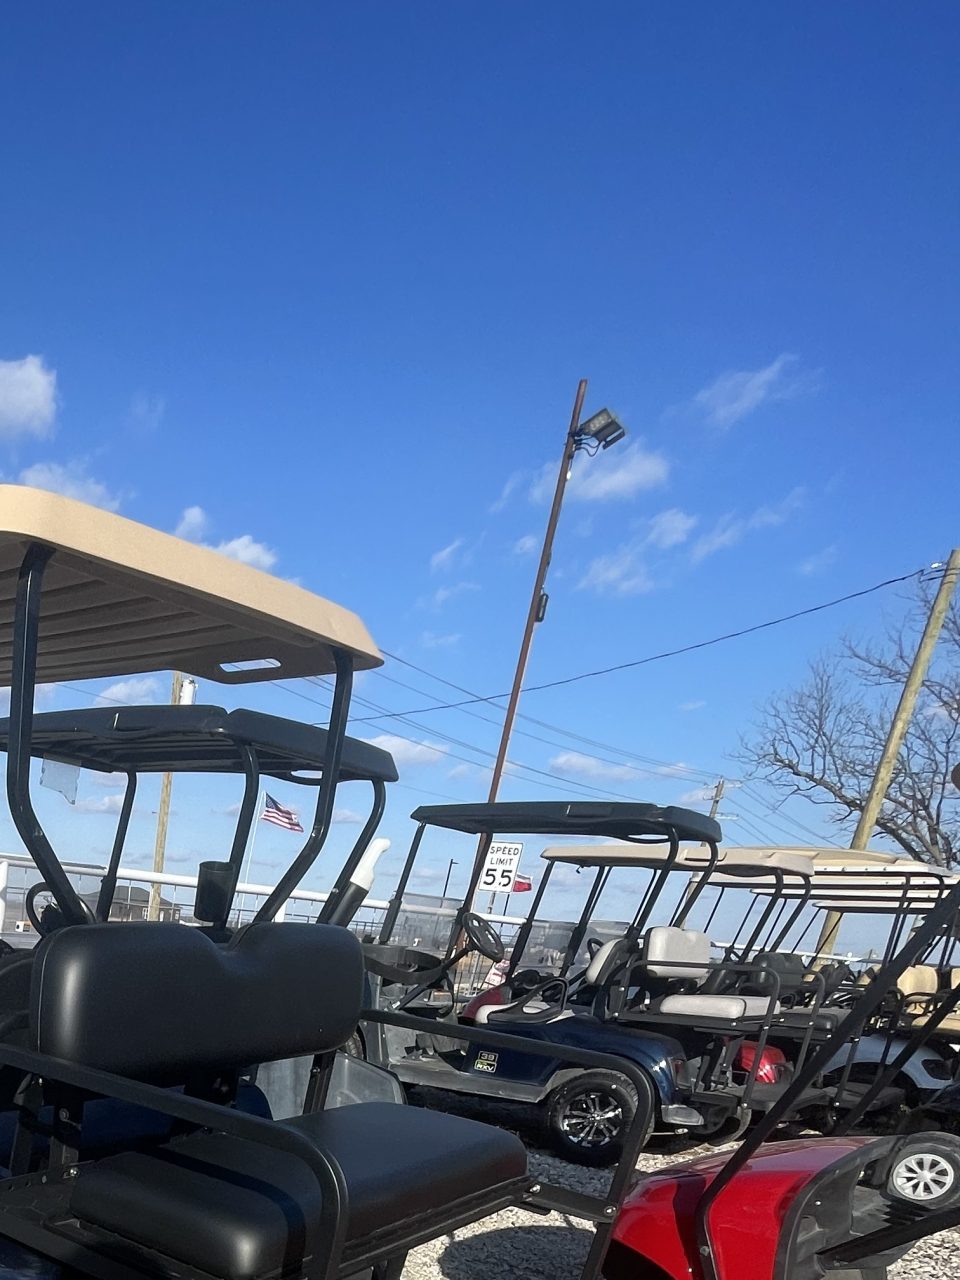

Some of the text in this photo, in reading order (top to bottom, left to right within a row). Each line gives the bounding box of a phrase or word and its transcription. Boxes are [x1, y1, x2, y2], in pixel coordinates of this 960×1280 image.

[490, 846, 520, 856] SPEED
[490, 857, 514, 866] LIMIT
[483, 868, 513, 887] 55
